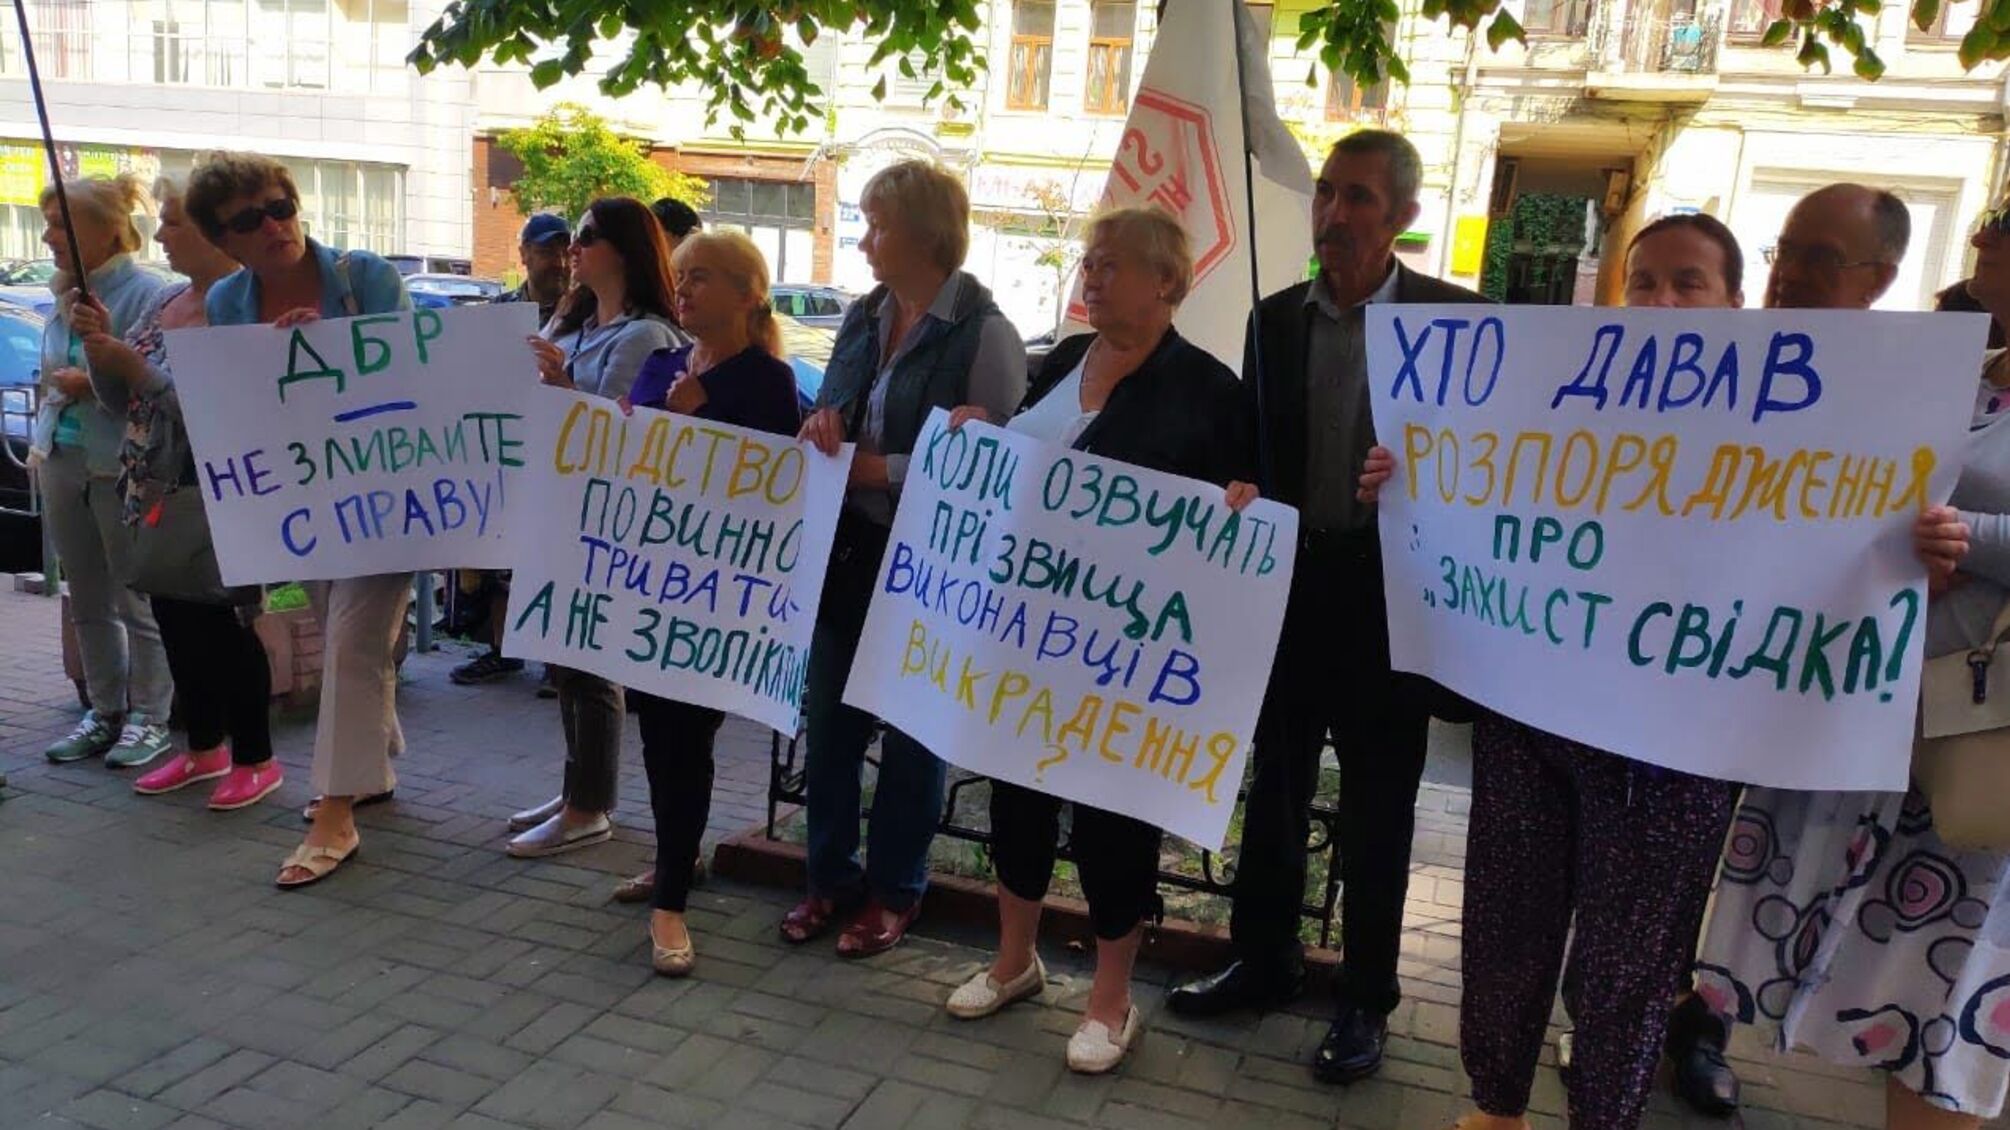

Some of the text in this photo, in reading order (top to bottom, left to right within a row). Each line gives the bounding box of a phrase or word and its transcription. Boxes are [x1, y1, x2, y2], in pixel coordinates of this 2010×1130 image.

[278, 308, 443, 403] ДБР
[1390, 316, 1823, 423] ХТО ДАВАВ
[205, 450, 282, 501] НЕ
[555, 401, 804, 505] СЛІДСТВО
[923, 427, 1276, 577] КОЛИ ОЗВУЧАТЬ
[1493, 514, 1604, 571] ПРО
[514, 581, 554, 638] А
[565, 588, 613, 650] НЕ
[1627, 589, 1919, 702] СВІДКА?
[901, 618, 1238, 804] ВИКРАДЕННЯ
